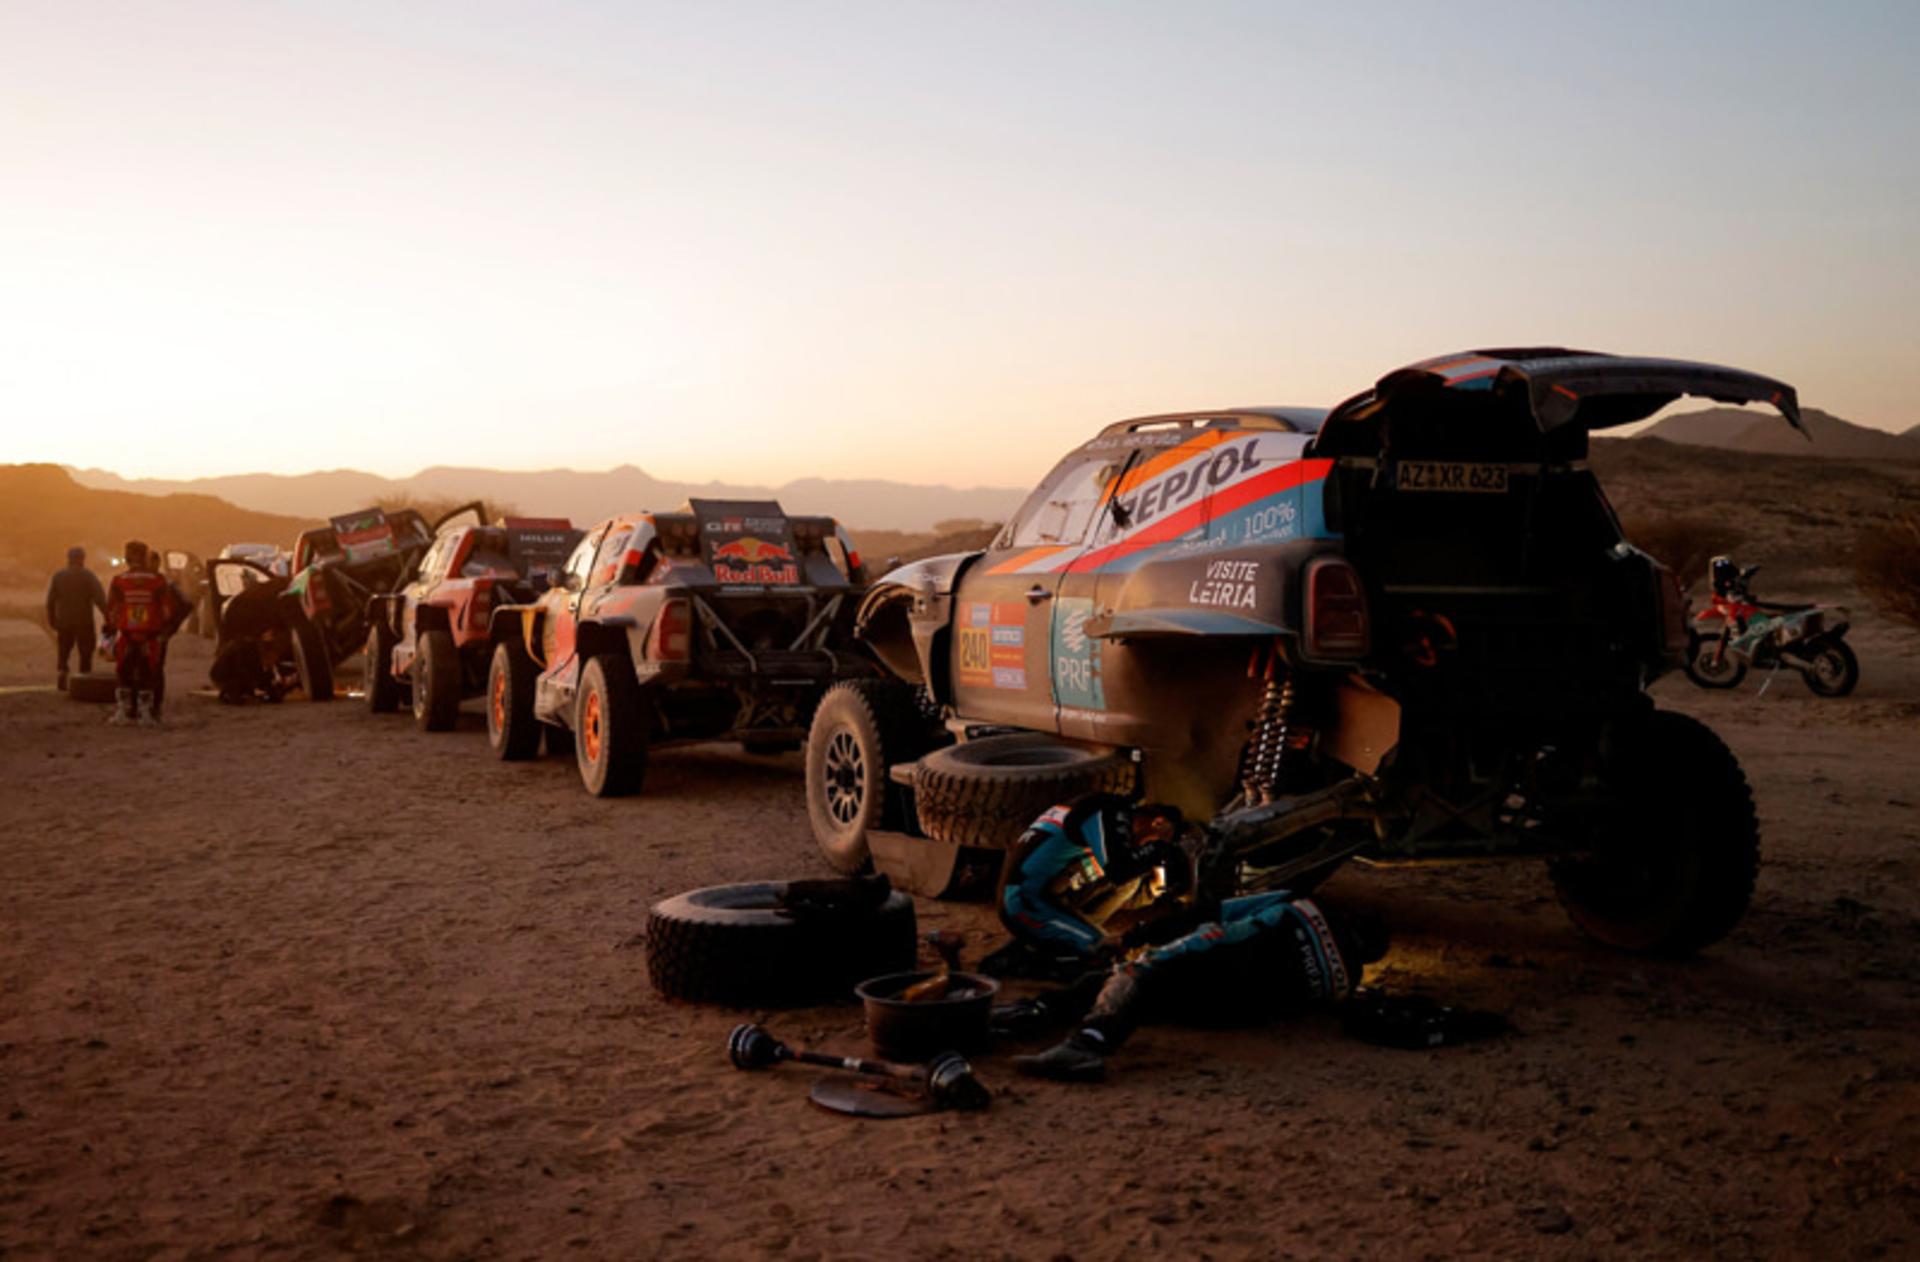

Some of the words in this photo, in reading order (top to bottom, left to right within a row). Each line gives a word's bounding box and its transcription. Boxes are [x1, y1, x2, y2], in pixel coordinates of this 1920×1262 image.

[1243, 501, 1296, 539] 100%
[715, 563, 756, 585] Red
[757, 563, 799, 585] Bull
[1206, 560, 1259, 582] VISITE
[1189, 581, 1257, 609] LEIRIA
